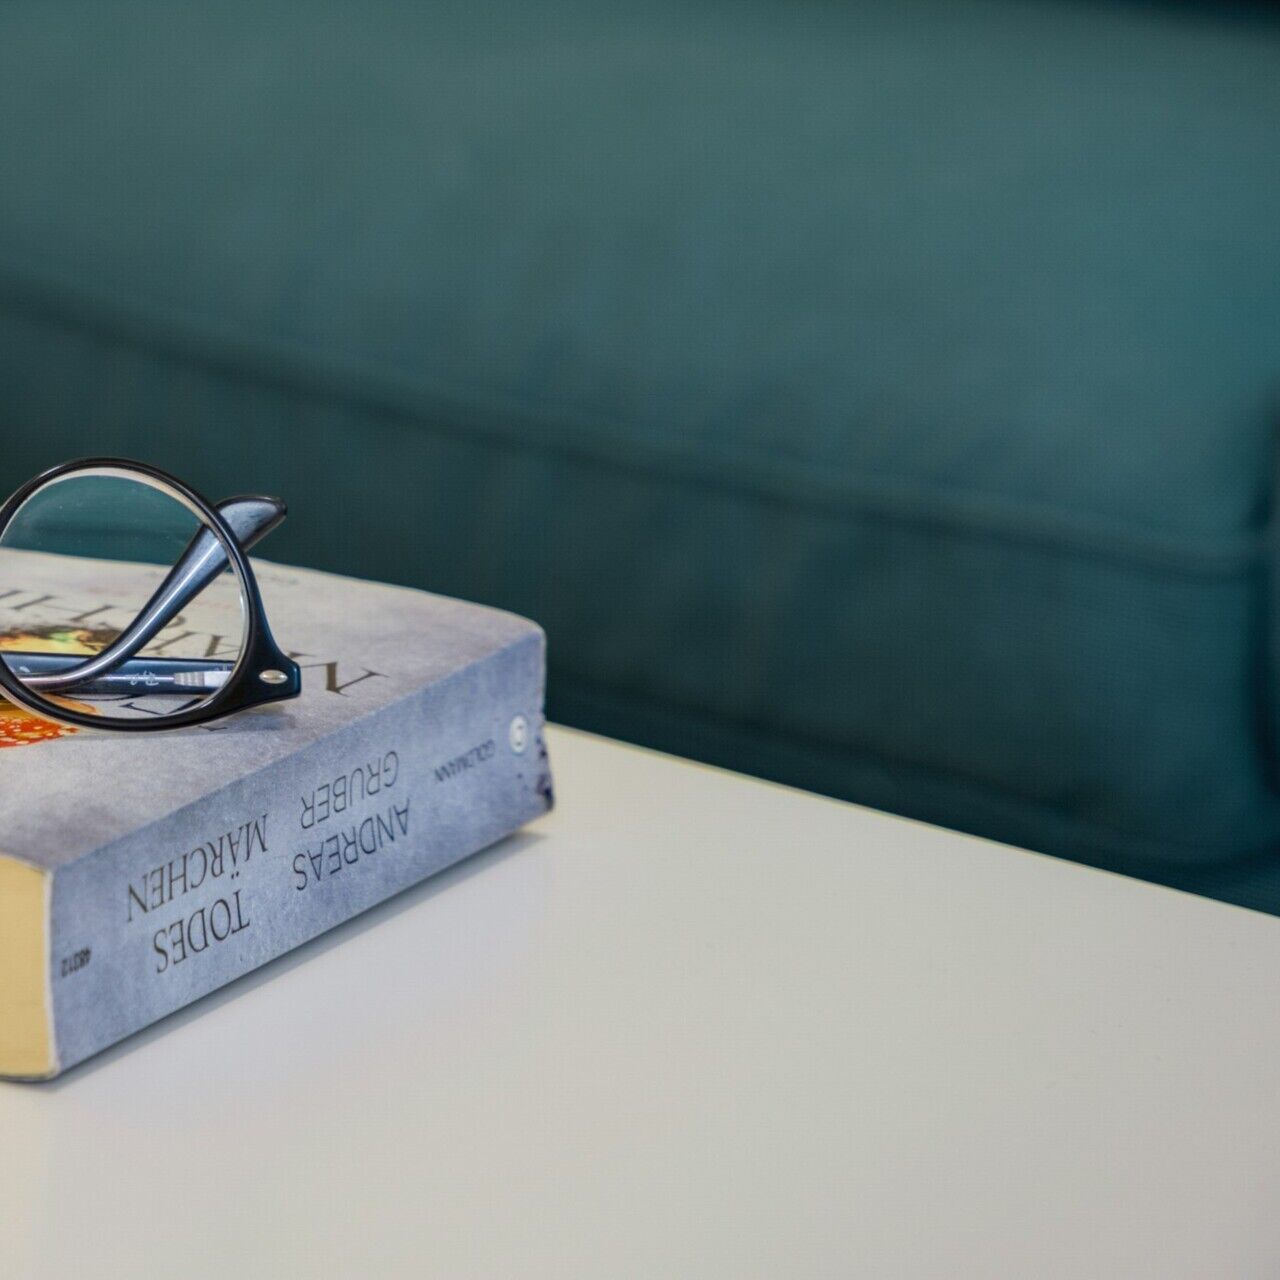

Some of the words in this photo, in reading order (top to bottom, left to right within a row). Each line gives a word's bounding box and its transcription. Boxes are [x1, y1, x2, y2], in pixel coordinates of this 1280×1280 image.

[300, 750, 400, 830] GRUBER
[127, 813, 269, 922] MÄRCHEN
[293, 797, 411, 892] ANDREAS
[152, 888, 251, 974] TODES
